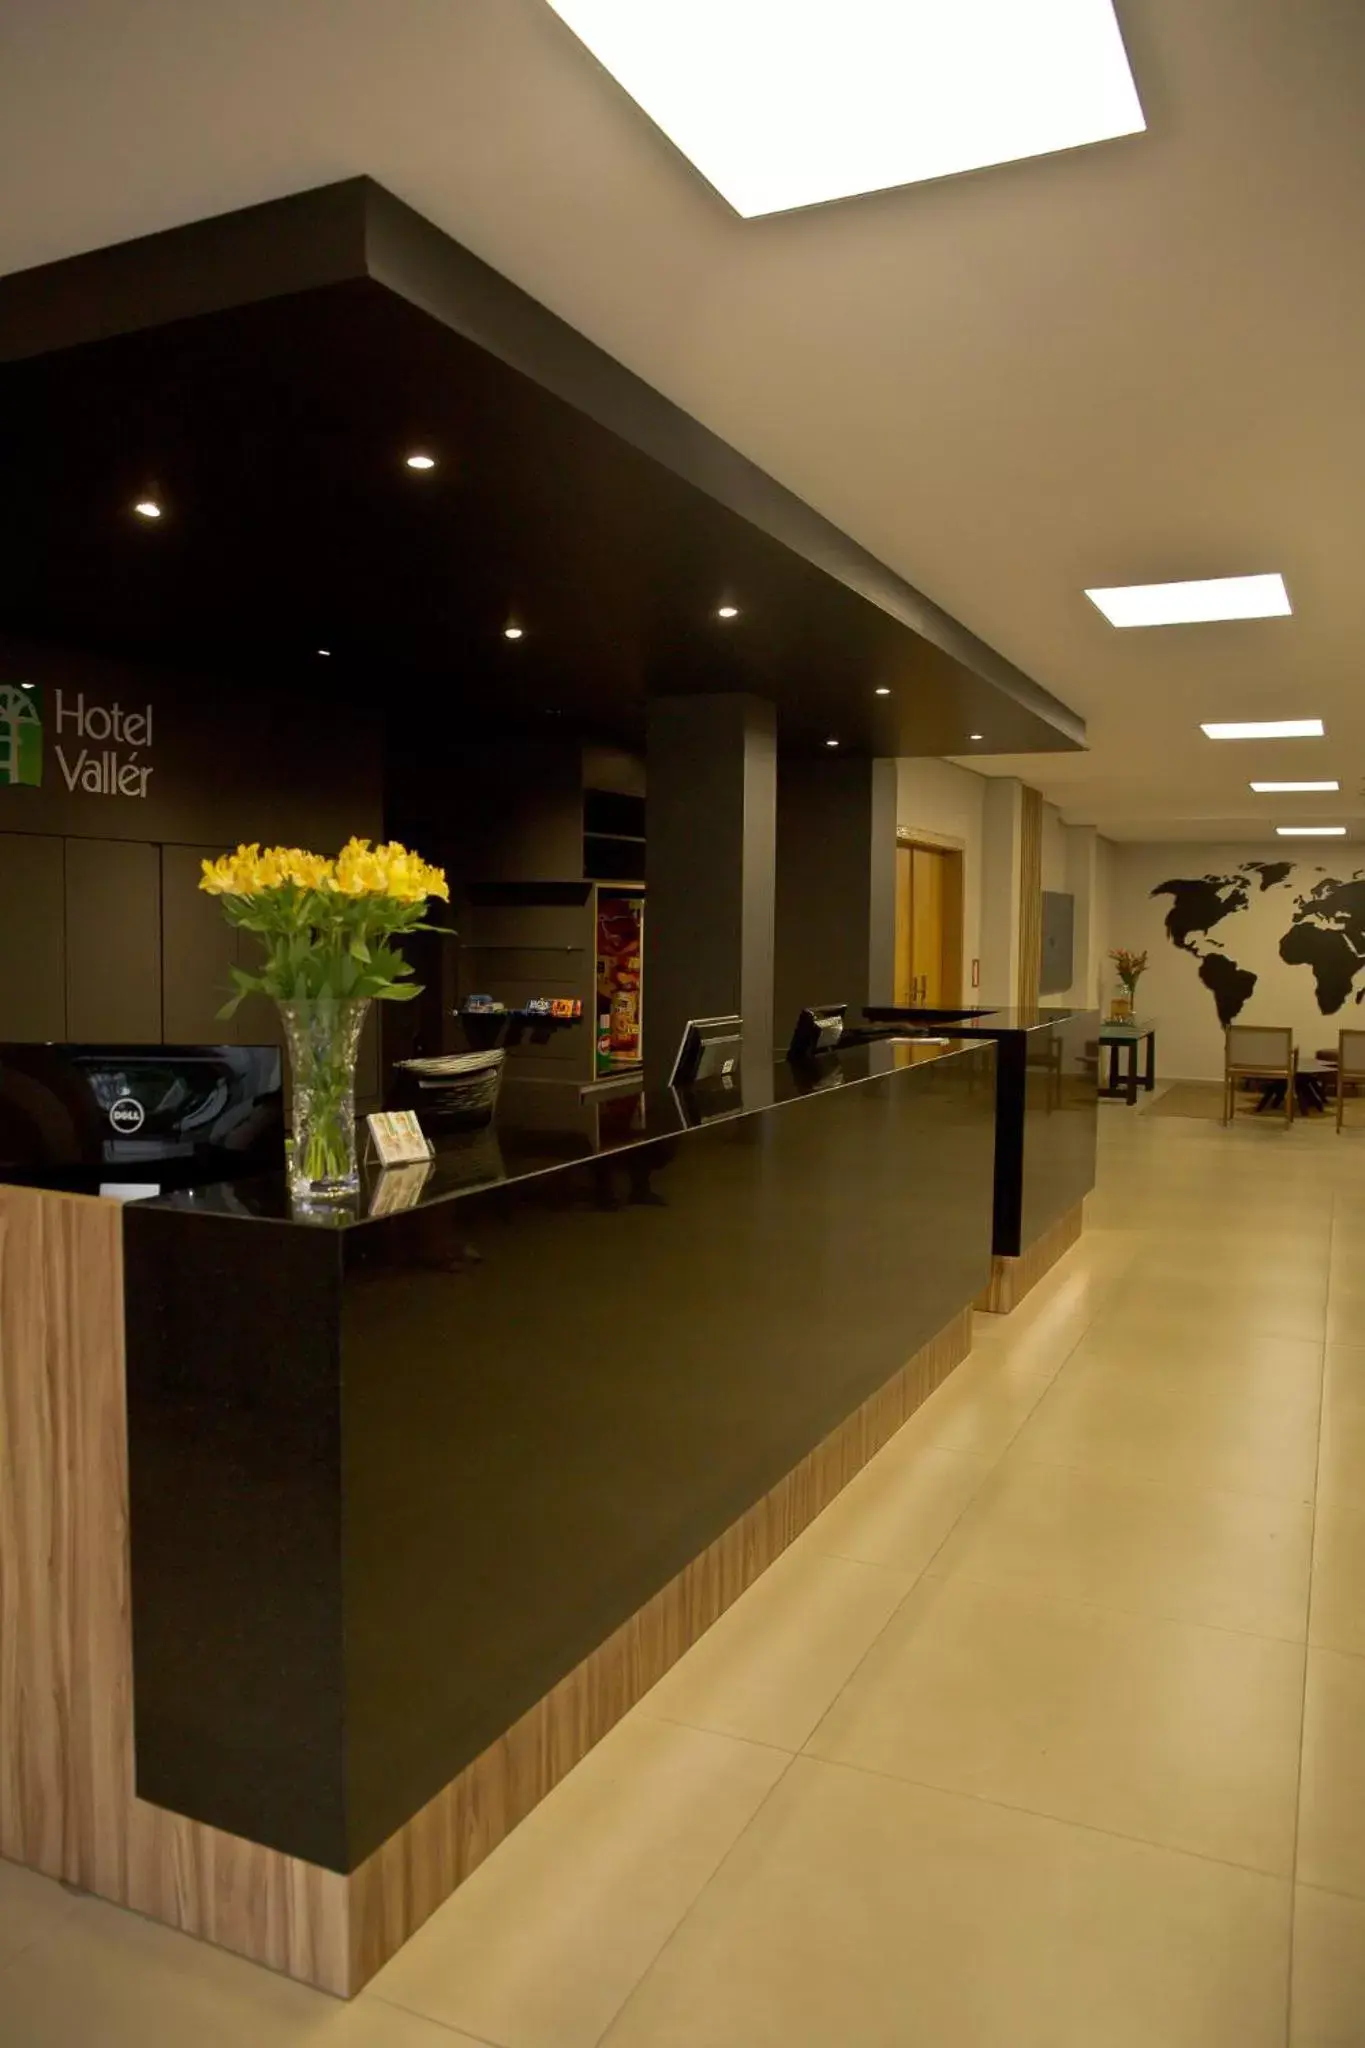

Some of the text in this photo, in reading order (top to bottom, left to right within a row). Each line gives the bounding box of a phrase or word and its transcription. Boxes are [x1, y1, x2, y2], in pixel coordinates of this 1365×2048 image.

[54, 688, 153, 747] Hotel
[54, 745, 154, 798] Vallér
[113, 1110, 140, 1121] DELL
